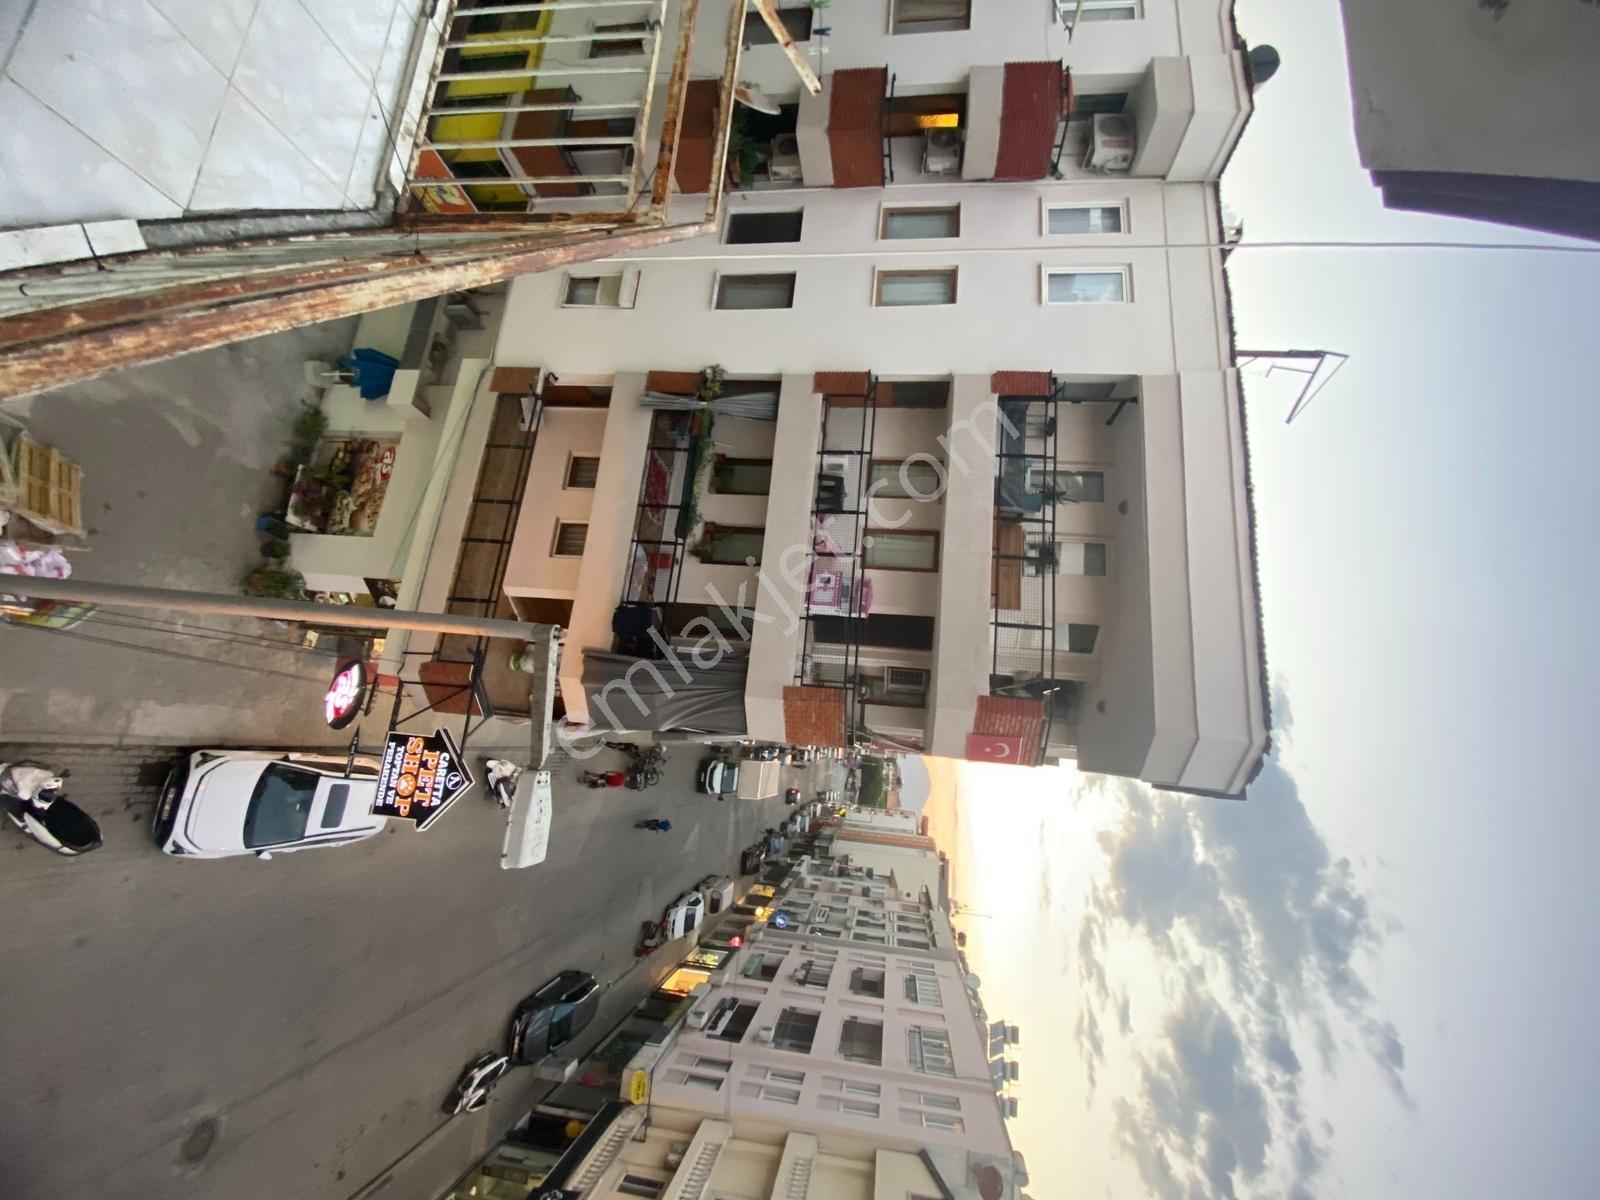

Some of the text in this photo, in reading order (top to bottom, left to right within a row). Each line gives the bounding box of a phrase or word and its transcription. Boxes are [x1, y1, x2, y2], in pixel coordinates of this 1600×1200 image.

[375, 741, 396, 807] PERAKENDE
[385, 746, 404, 805] TOPTAN VE
[395, 738, 424, 816] SHOP
[413, 749, 440, 807] PET
[430, 752, 450, 806] CARETTA
